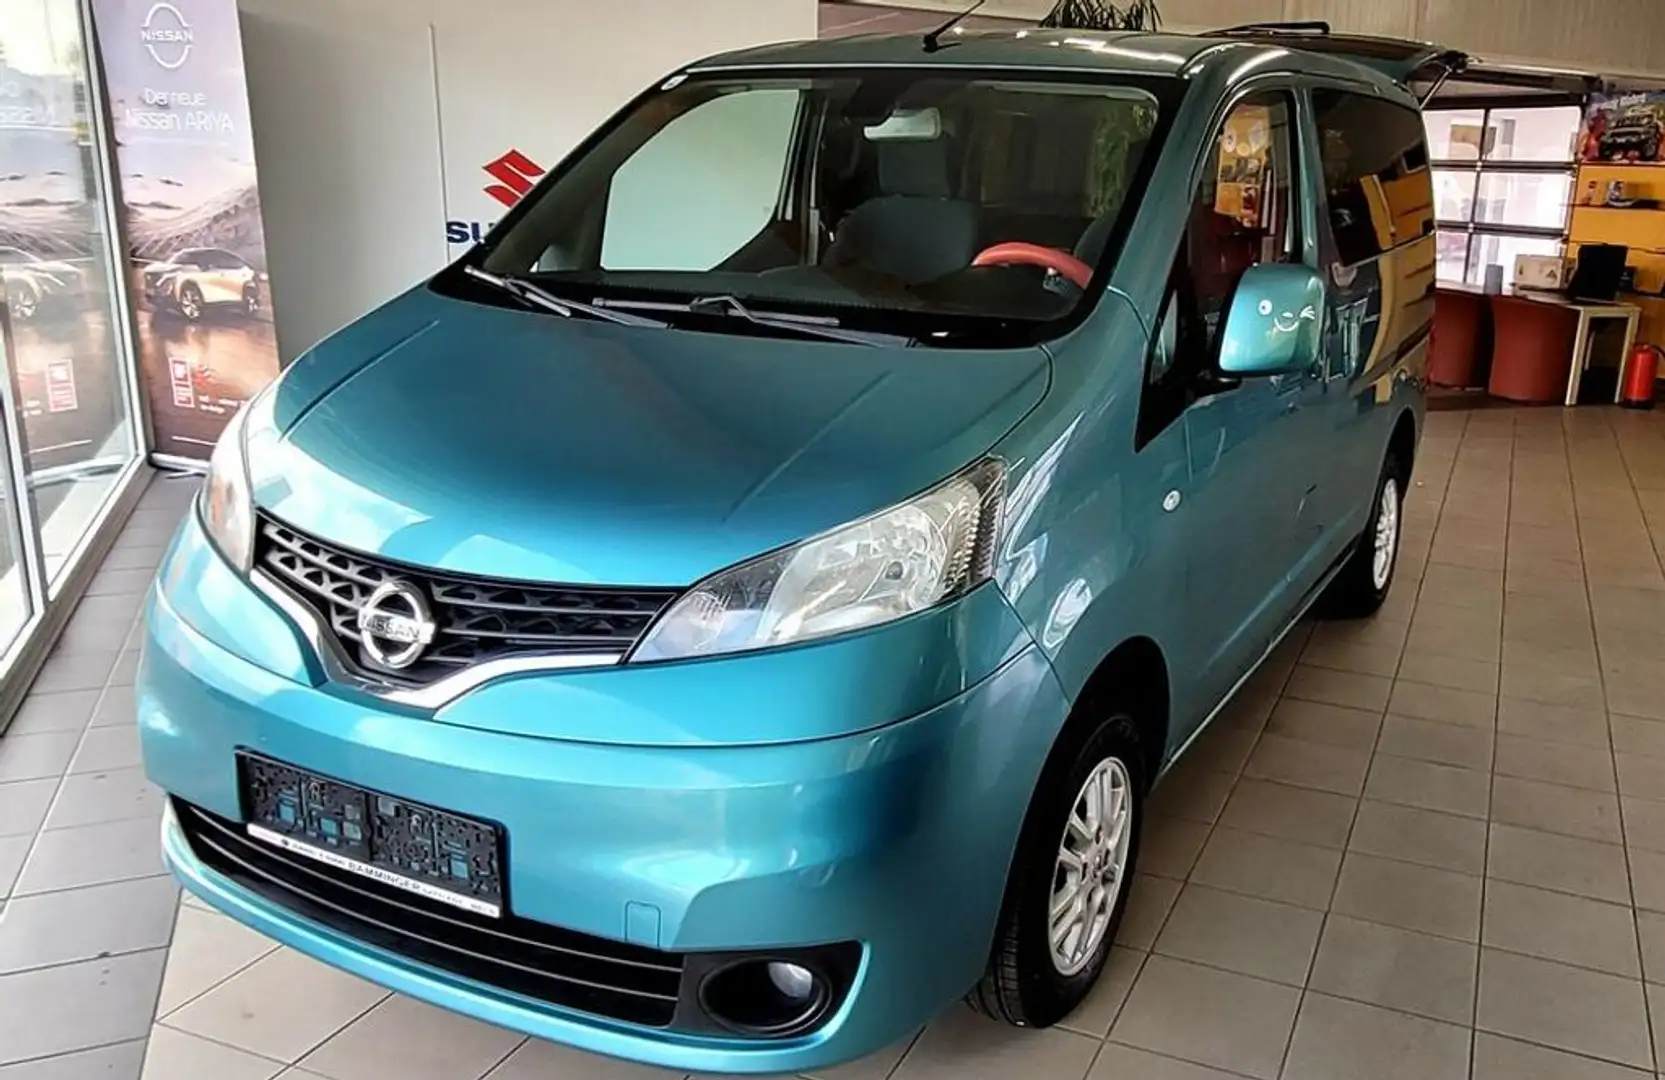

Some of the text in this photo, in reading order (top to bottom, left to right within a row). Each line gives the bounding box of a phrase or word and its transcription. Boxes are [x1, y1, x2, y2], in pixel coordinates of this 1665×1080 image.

[141, 29, 194, 42] NISSAN
[144, 87, 206, 106] Der neue
[126, 108, 235, 133] Nissan ARIYA
[365, 615, 421, 638] NISSAN
